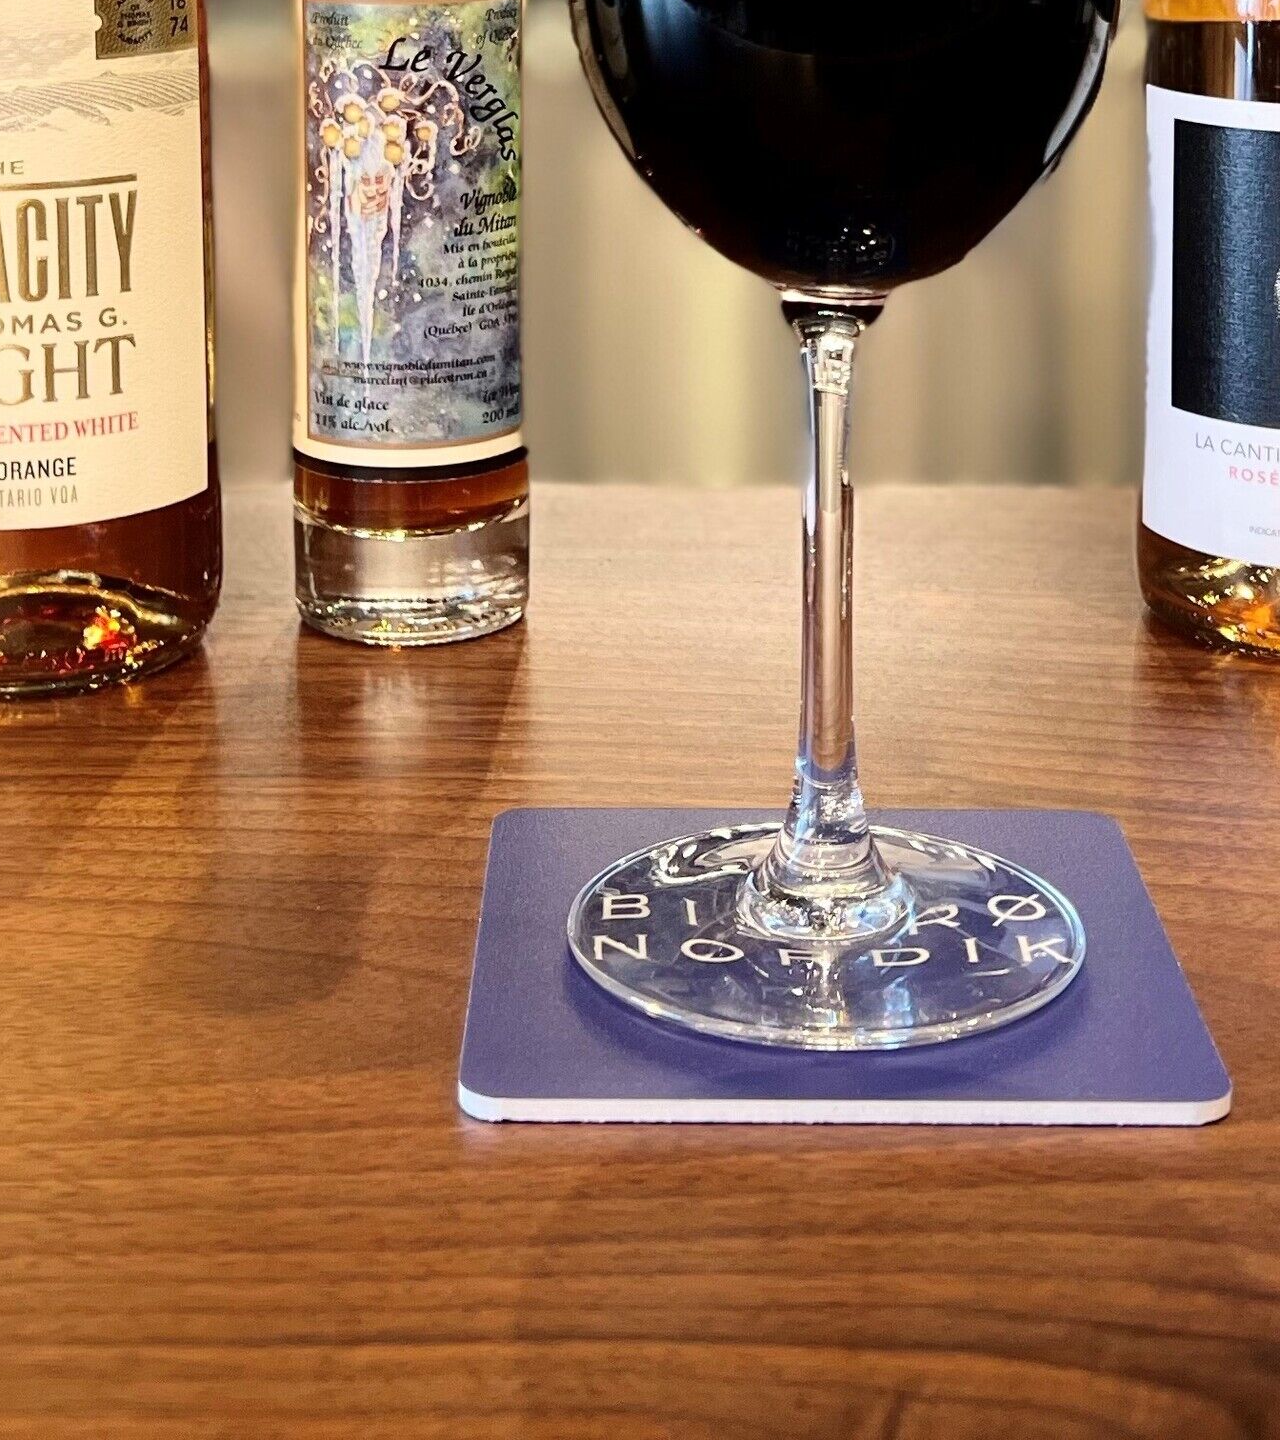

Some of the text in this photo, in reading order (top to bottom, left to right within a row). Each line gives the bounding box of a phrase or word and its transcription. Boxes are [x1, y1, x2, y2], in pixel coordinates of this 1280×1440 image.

[169, 15, 188, 37] 74
[378, 37, 519, 161] Le Verglas
[453, 216, 475, 237] du
[444, 243, 464, 254] Mis
[468, 243, 480, 252] en
[468, 256, 478, 268] la
[456, 273, 492, 285] chemin
[98, 306, 128, 327] G.
[336, 394, 350, 408] de
[354, 396, 389, 414] glace
[74, 411, 140, 436] WHITE
[482, 408, 504, 423] 200
[1195, 432, 1215, 453] LA
[1228, 464, 1280, 486] ROSÉ
[51, 485, 78, 504] VQA
[602, 893, 1047, 935] BIRØ
